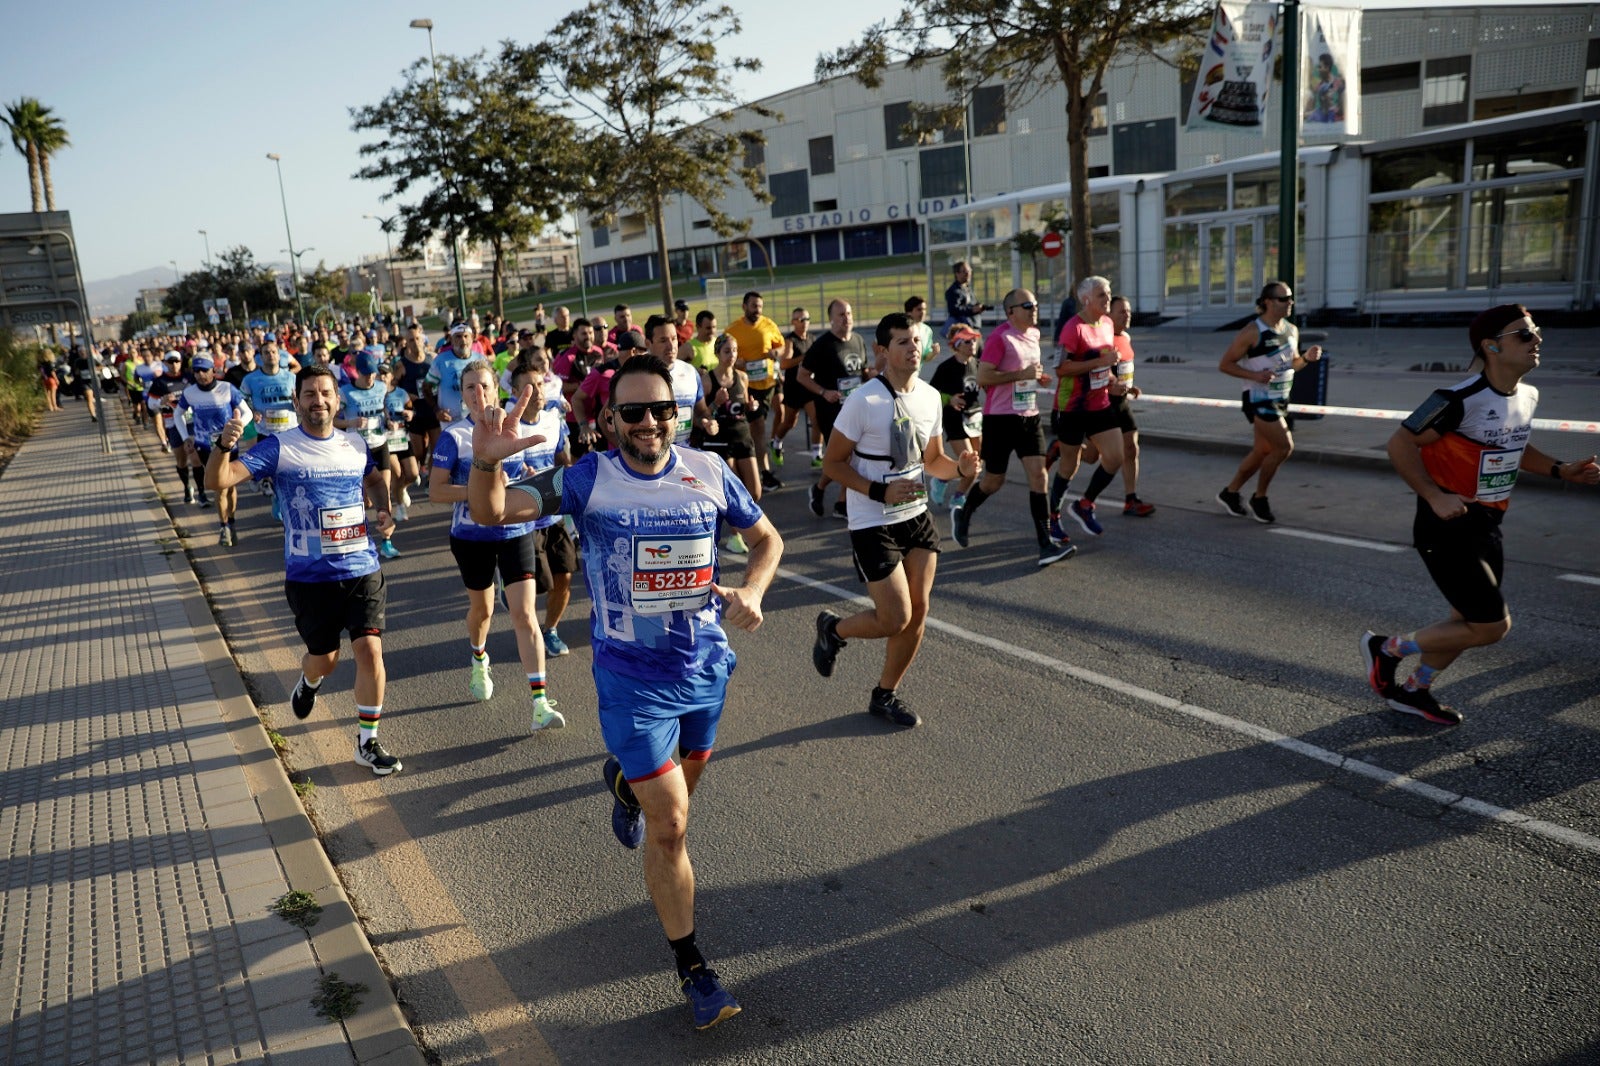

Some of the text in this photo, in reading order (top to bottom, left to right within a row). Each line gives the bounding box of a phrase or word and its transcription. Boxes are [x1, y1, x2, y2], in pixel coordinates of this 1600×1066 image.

[783, 207, 871, 232] ESTADIO
[297, 466, 313, 479] 31
[618, 508, 639, 528] 31
[653, 517, 689, 528] MARATÓN
[334, 526, 360, 540] 4996
[654, 571, 697, 589] 5232
